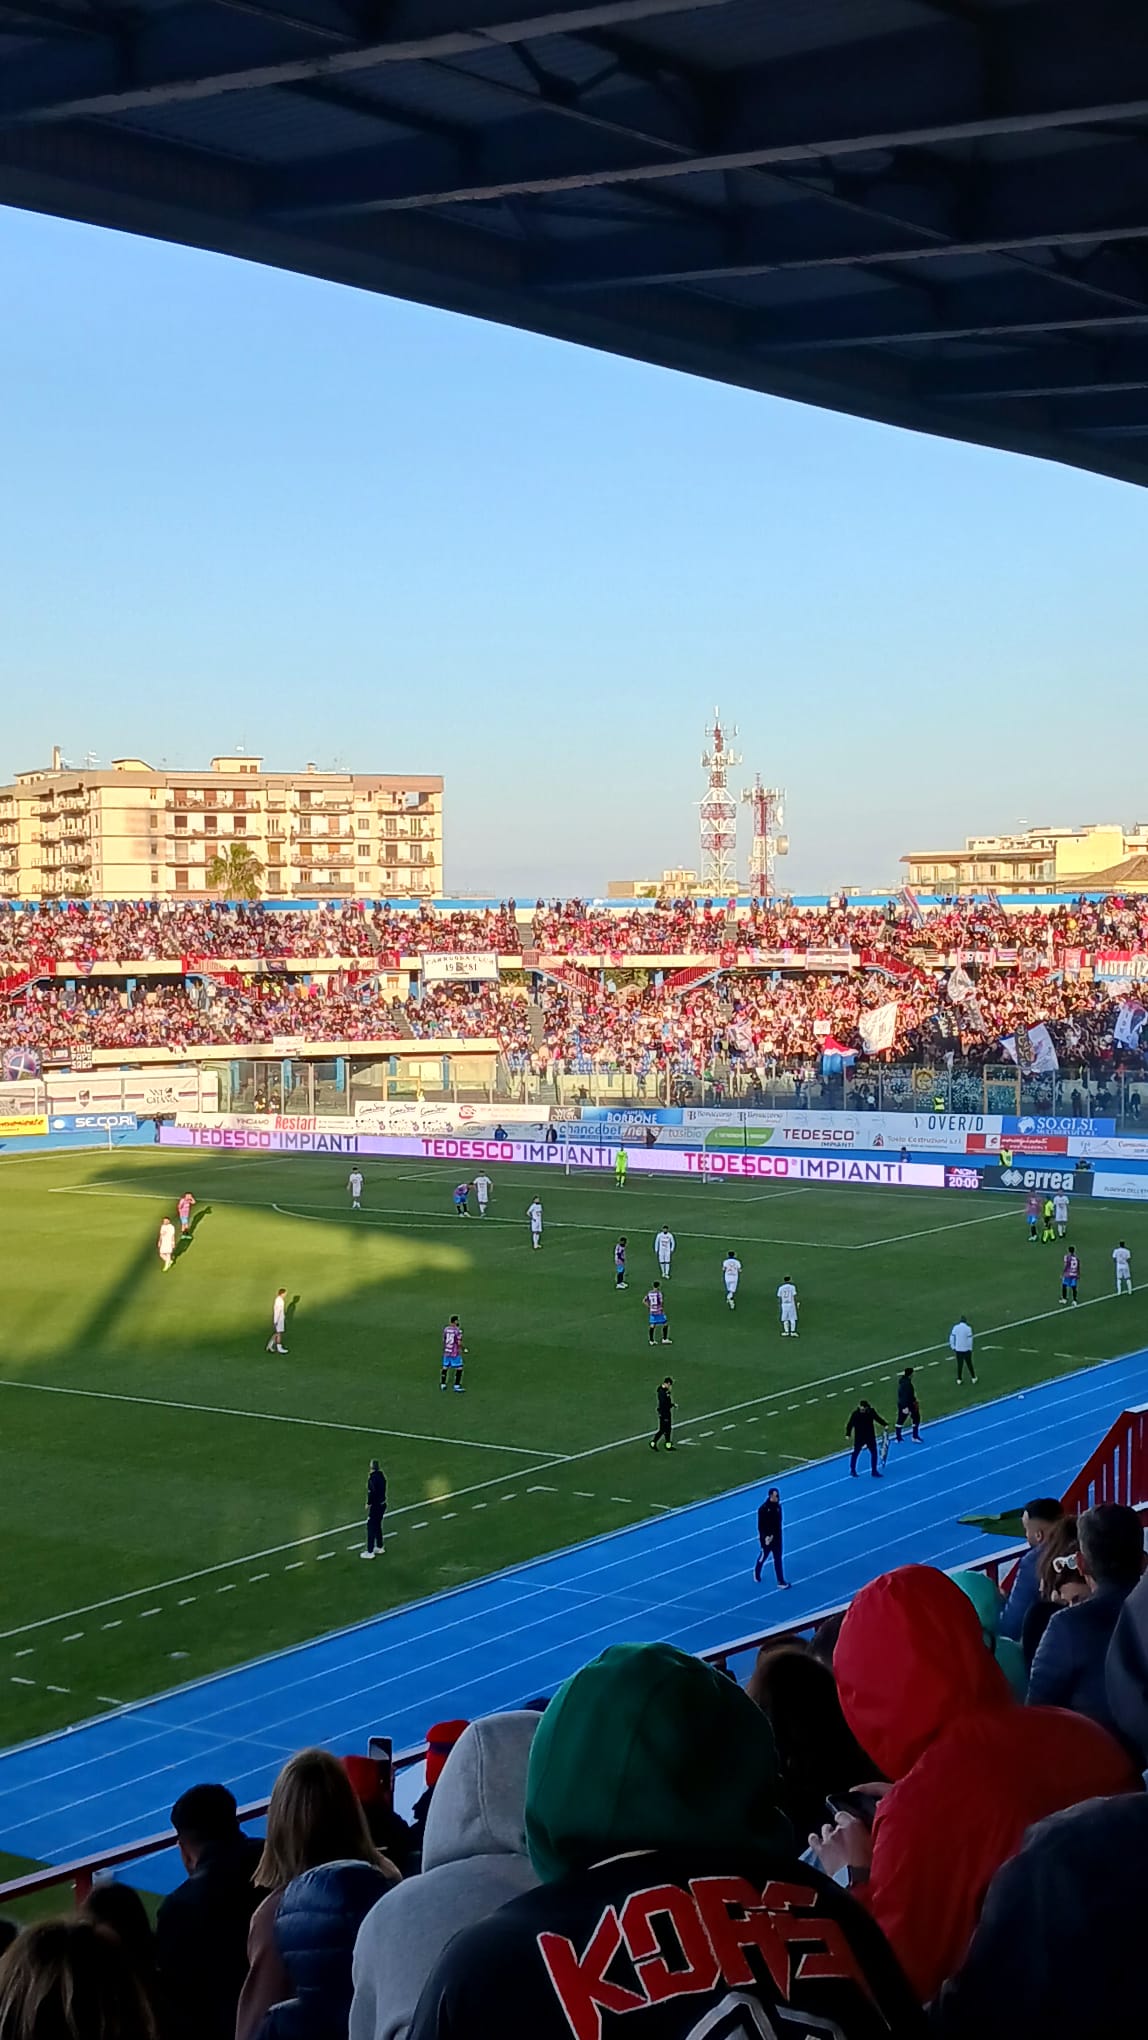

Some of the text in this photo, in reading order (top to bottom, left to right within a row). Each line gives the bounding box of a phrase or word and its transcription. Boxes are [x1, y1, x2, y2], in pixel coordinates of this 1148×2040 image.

[70, 1045, 92, 1054] CIAO
[275, 1115, 317, 1131] Restart
[607, 1111, 657, 1125] BORBONE
[189, 1128, 359, 1153] TEDESCO IMPIANTI
[783, 1129, 855, 1141] TEDESCO
[421, 1138, 612, 1166] TEDESCO IMPIANTI
[684, 1152, 903, 1183] TEDESCO IMPIANTI
[948, 1176, 979, 1188] 20:00
[1023, 1170, 1074, 1191] errea
